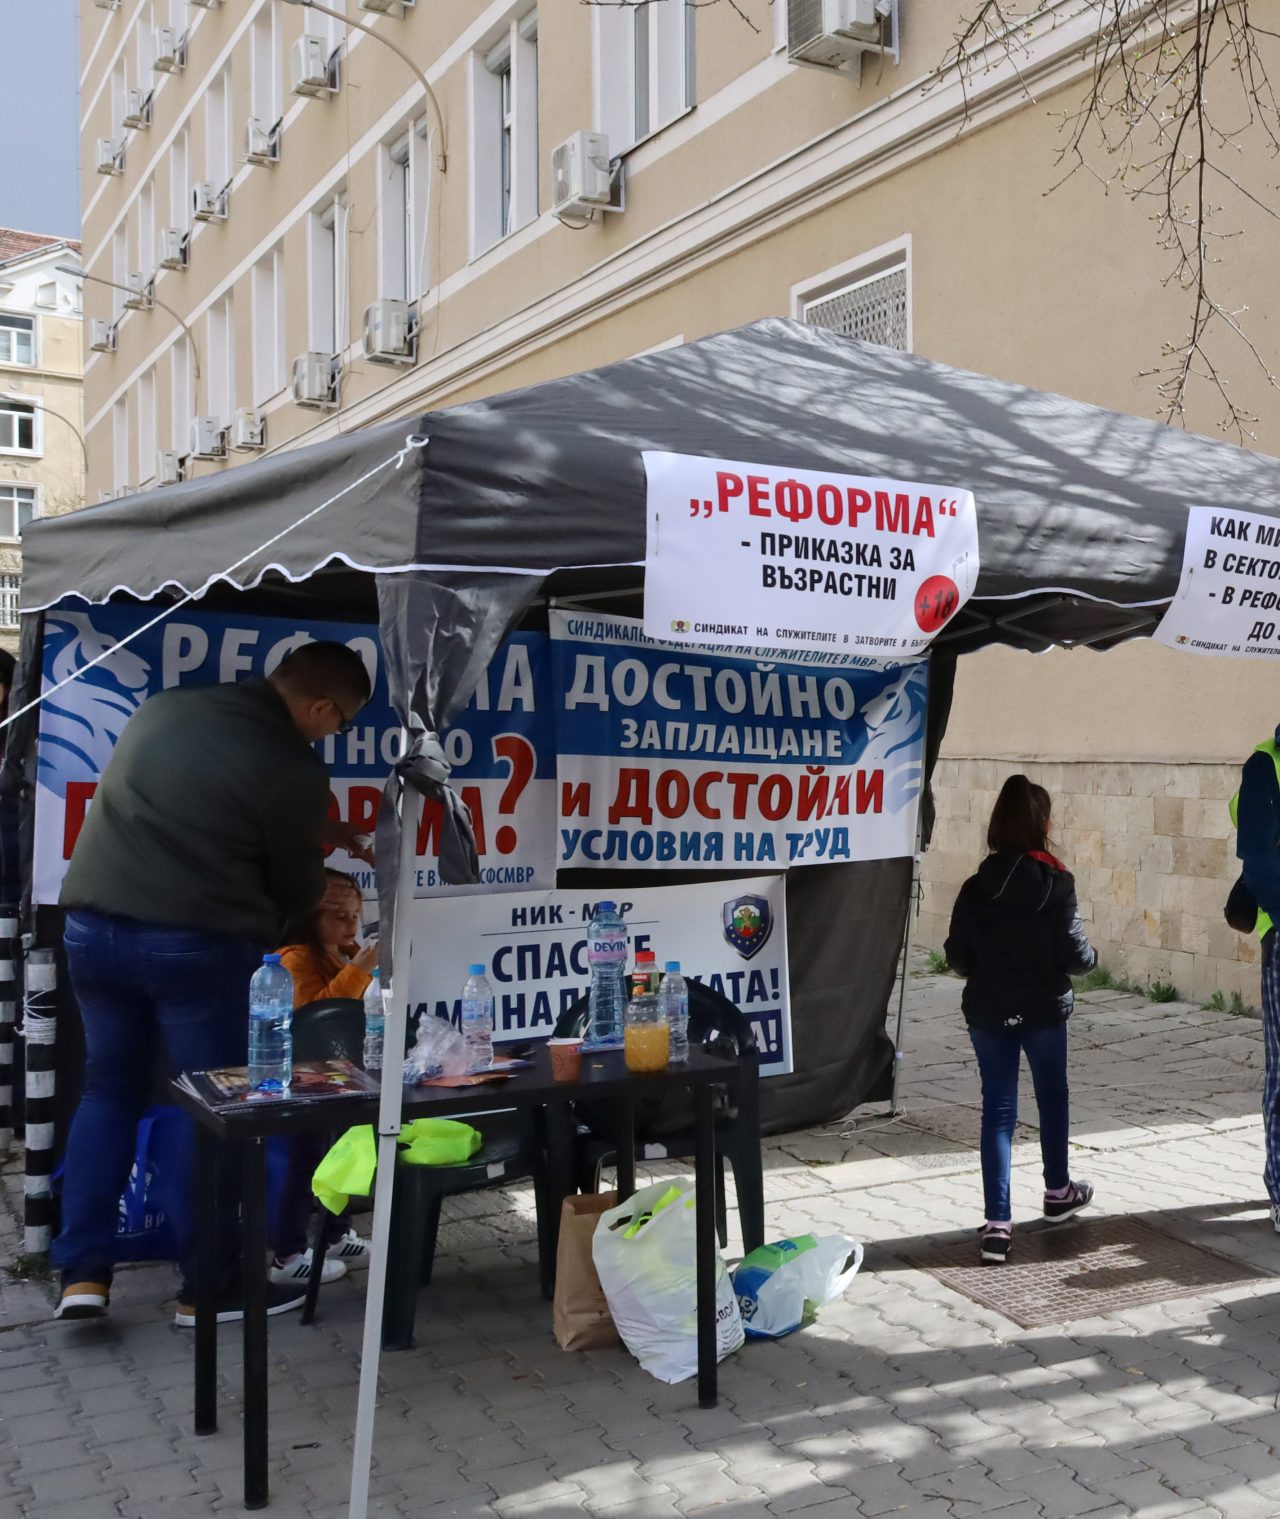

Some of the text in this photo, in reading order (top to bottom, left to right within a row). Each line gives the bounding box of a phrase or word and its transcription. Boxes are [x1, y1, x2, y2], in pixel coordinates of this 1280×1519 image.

[690, 471, 957, 538] „РЕФОРМА“
[1210, 516, 1251, 541] КАК
[760, 532, 882, 568] ПРИКАЗКА
[889, 547, 916, 571] ЗА
[1203, 549, 1218, 569] В
[762, 564, 897, 600] ВЪЗРАСТНИ
[918, 589, 955, 620] +18
[1221, 586, 1235, 604] В
[694, 622, 748, 636] СИНДИКАТ
[756, 627, 769, 637] НА
[776, 628, 837, 643] СЛУЖИТЕЛИТЕ
[843, 634, 849, 644] В
[855, 635, 897, 647] ЗАТВОРИТЕ
[1247, 621, 1276, 642] ДО
[755, 646, 838, 665] СЛУЖИТЕЛИТЕ
[840, 654, 849, 665] В
[850, 656, 877, 668] МВР
[1190, 639, 1228, 651] СИНДИКАТ
[1231, 644, 1241, 652] НА
[565, 654, 856, 721] ДОСТОЙНО
[620, 718, 842, 760] ЗАПЛАЩАНЕ
[608, 765, 884, 826] ДОСТОЙНИ
[561, 827, 850, 862] УСЛОВИЯ НА ТРУД
[480, 866, 535, 884] СФСМВР
[511, 904, 563, 927] НИК
[582, 902, 634, 922] МР
[594, 941, 626, 953] DEVIN
